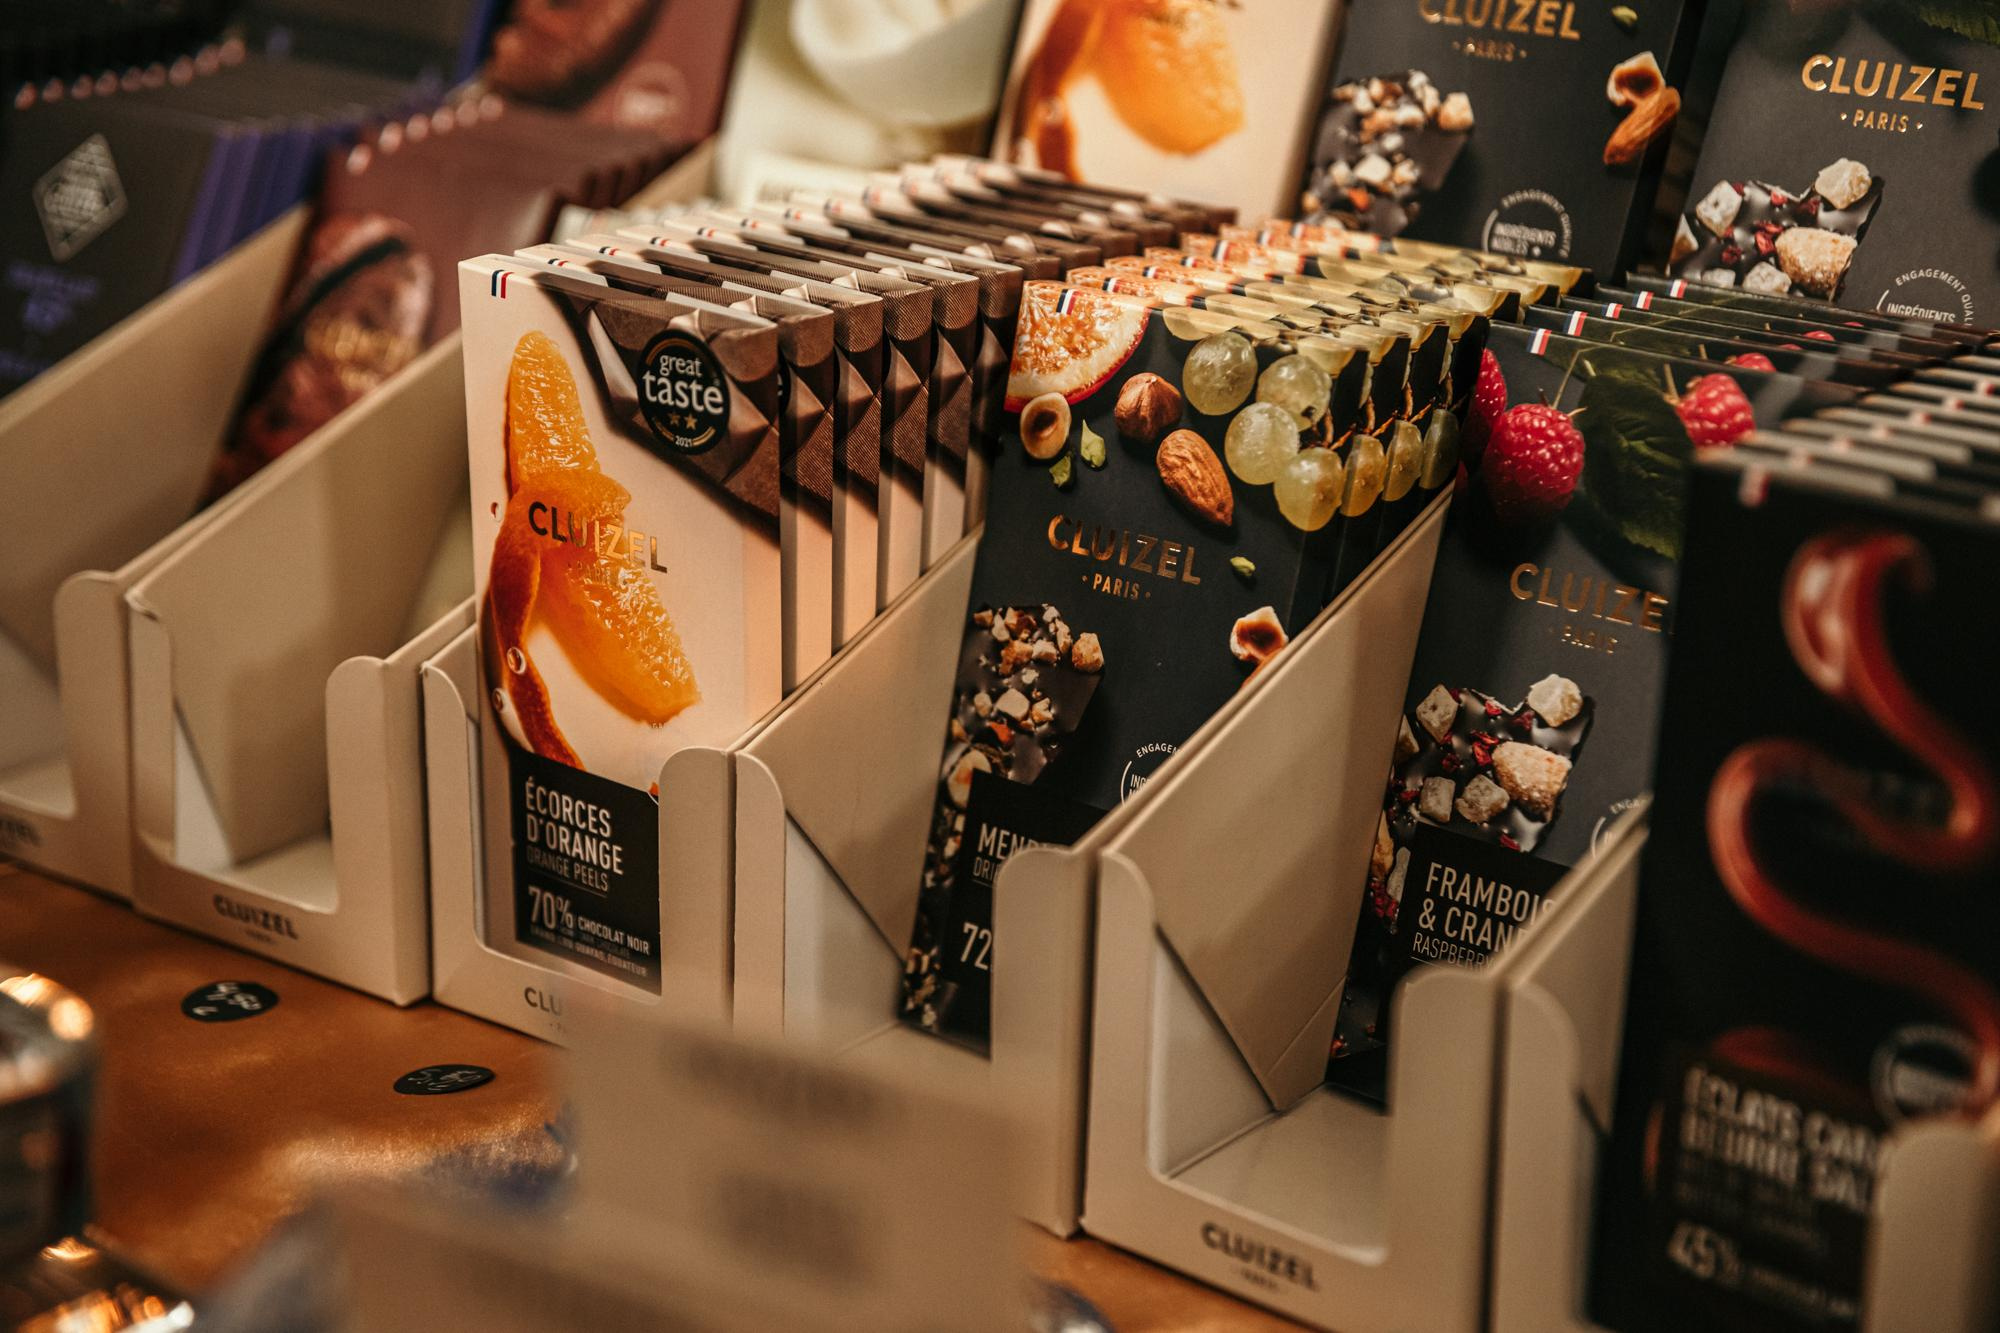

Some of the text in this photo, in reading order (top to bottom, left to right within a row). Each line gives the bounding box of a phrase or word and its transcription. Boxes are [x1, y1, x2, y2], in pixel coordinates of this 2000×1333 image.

[1420, 0, 1581, 40] CLUIZEL
[1802, 54, 1985, 111] CLUIZEL
[1853, 109, 1910, 133] PARIS
[1895, 268, 1966, 293] ENGAGEMENT
[659, 354, 703, 377] great
[642, 370, 724, 415] taste
[528, 501, 668, 574] CLUIZEL
[1047, 514, 1201, 585] CLUIZEL
[1093, 572, 1140, 601] PARIS
[1510, 562, 1671, 633] CLUIZE
[525, 776, 611, 838] ÉCORCES
[526, 814, 624, 875] D'ORANGE
[526, 845, 609, 892] ORANGE PEELS
[528, 885, 575, 930] 70%
[577, 916, 626, 946] CHOCOLAT
[626, 934, 651, 956] NOIR
[1418, 898, 1436, 931] &
